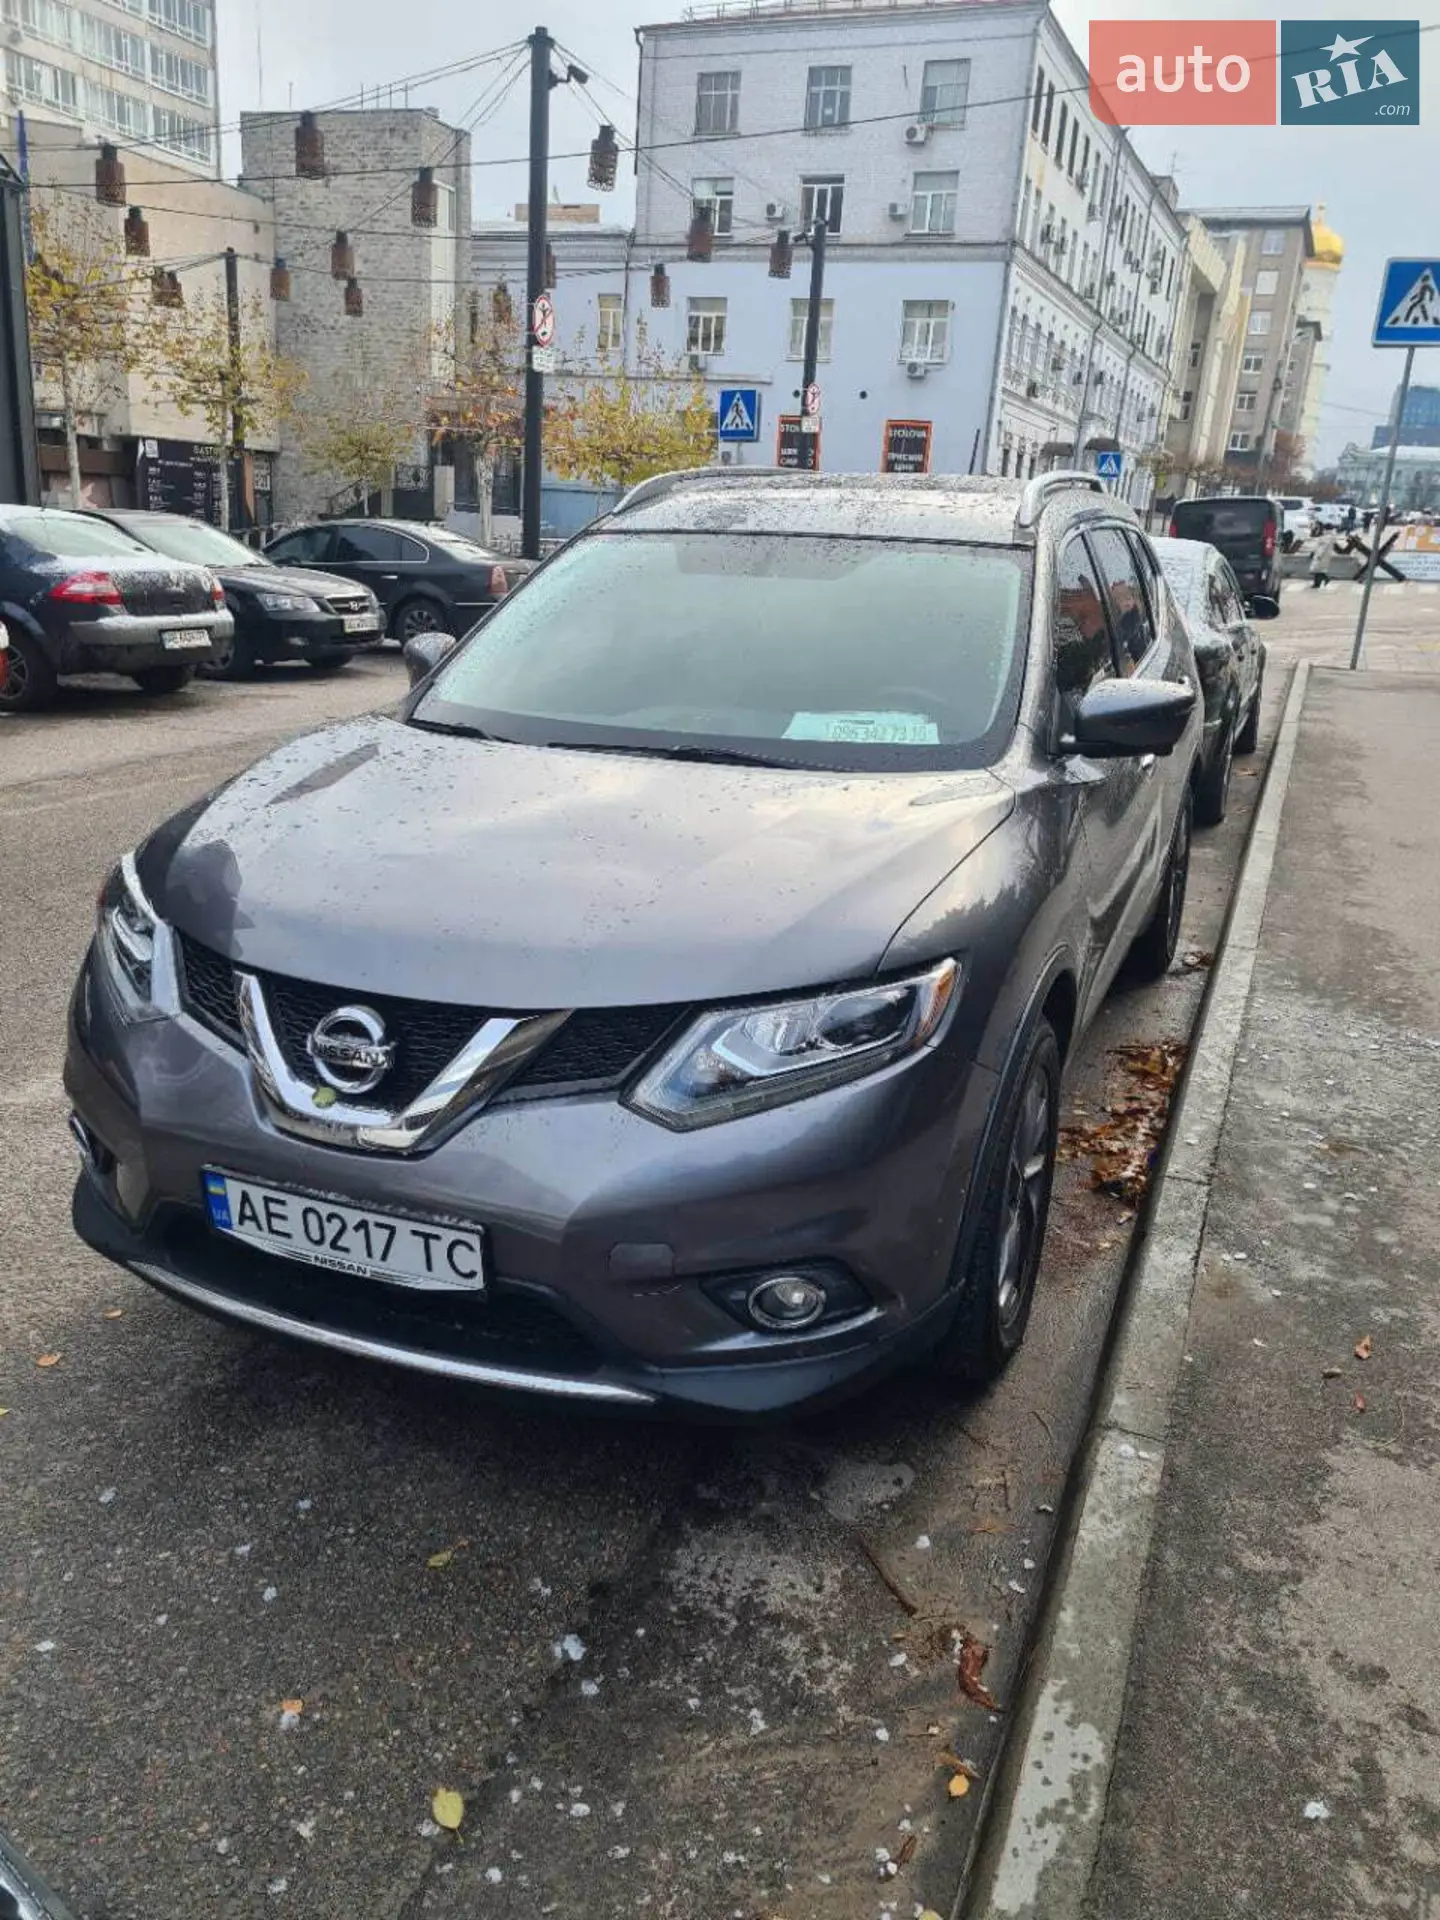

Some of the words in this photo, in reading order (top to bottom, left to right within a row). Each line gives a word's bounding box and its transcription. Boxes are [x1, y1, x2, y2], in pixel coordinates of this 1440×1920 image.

[315, 1041, 387, 1067] NISSAN
[211, 1207, 230, 1223] UA
[238, 1190, 292, 1239] AE
[302, 1206, 397, 1262] 0217
[411, 1229, 478, 1280] TC
[314, 1254, 368, 1275] NISSAN
